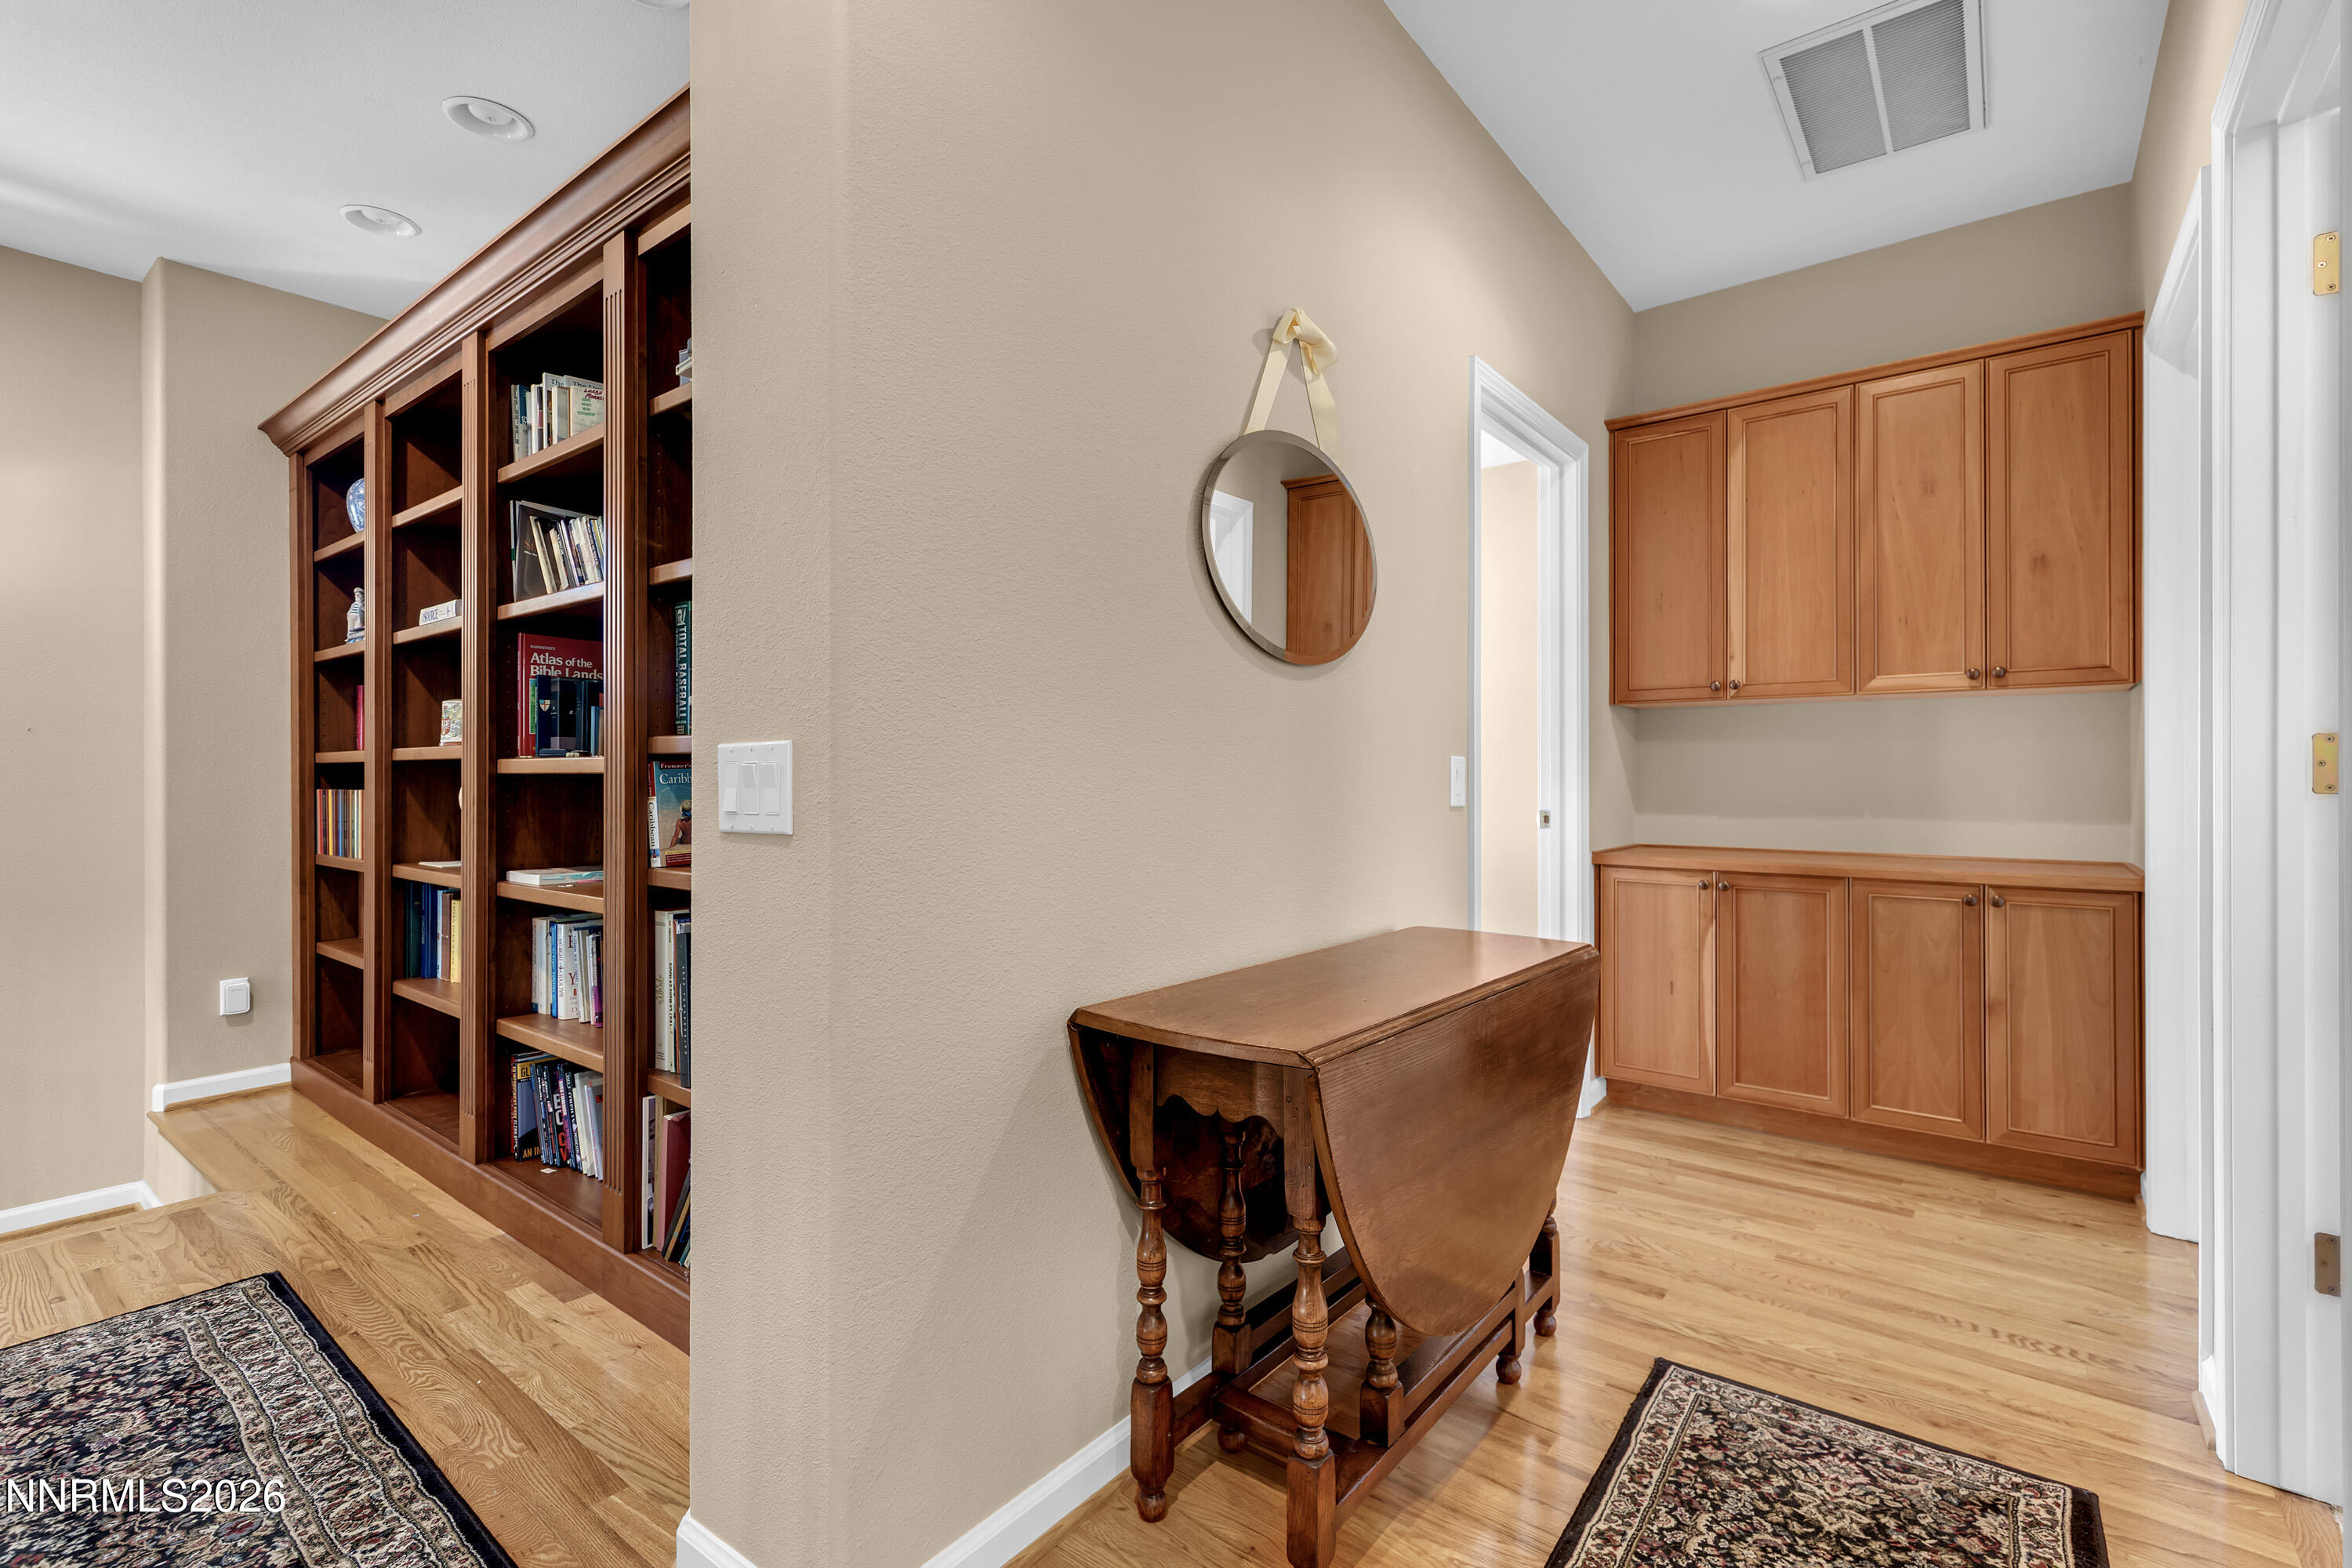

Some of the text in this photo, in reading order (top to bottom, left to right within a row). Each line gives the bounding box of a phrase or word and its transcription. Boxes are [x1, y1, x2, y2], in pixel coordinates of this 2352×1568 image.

[678, 626, 687, 658] TOTAL
[530, 652, 593, 668] Atlas of the
[530, 665, 604, 680] Bible Lands
[678, 663, 687, 718] BASEBALL
